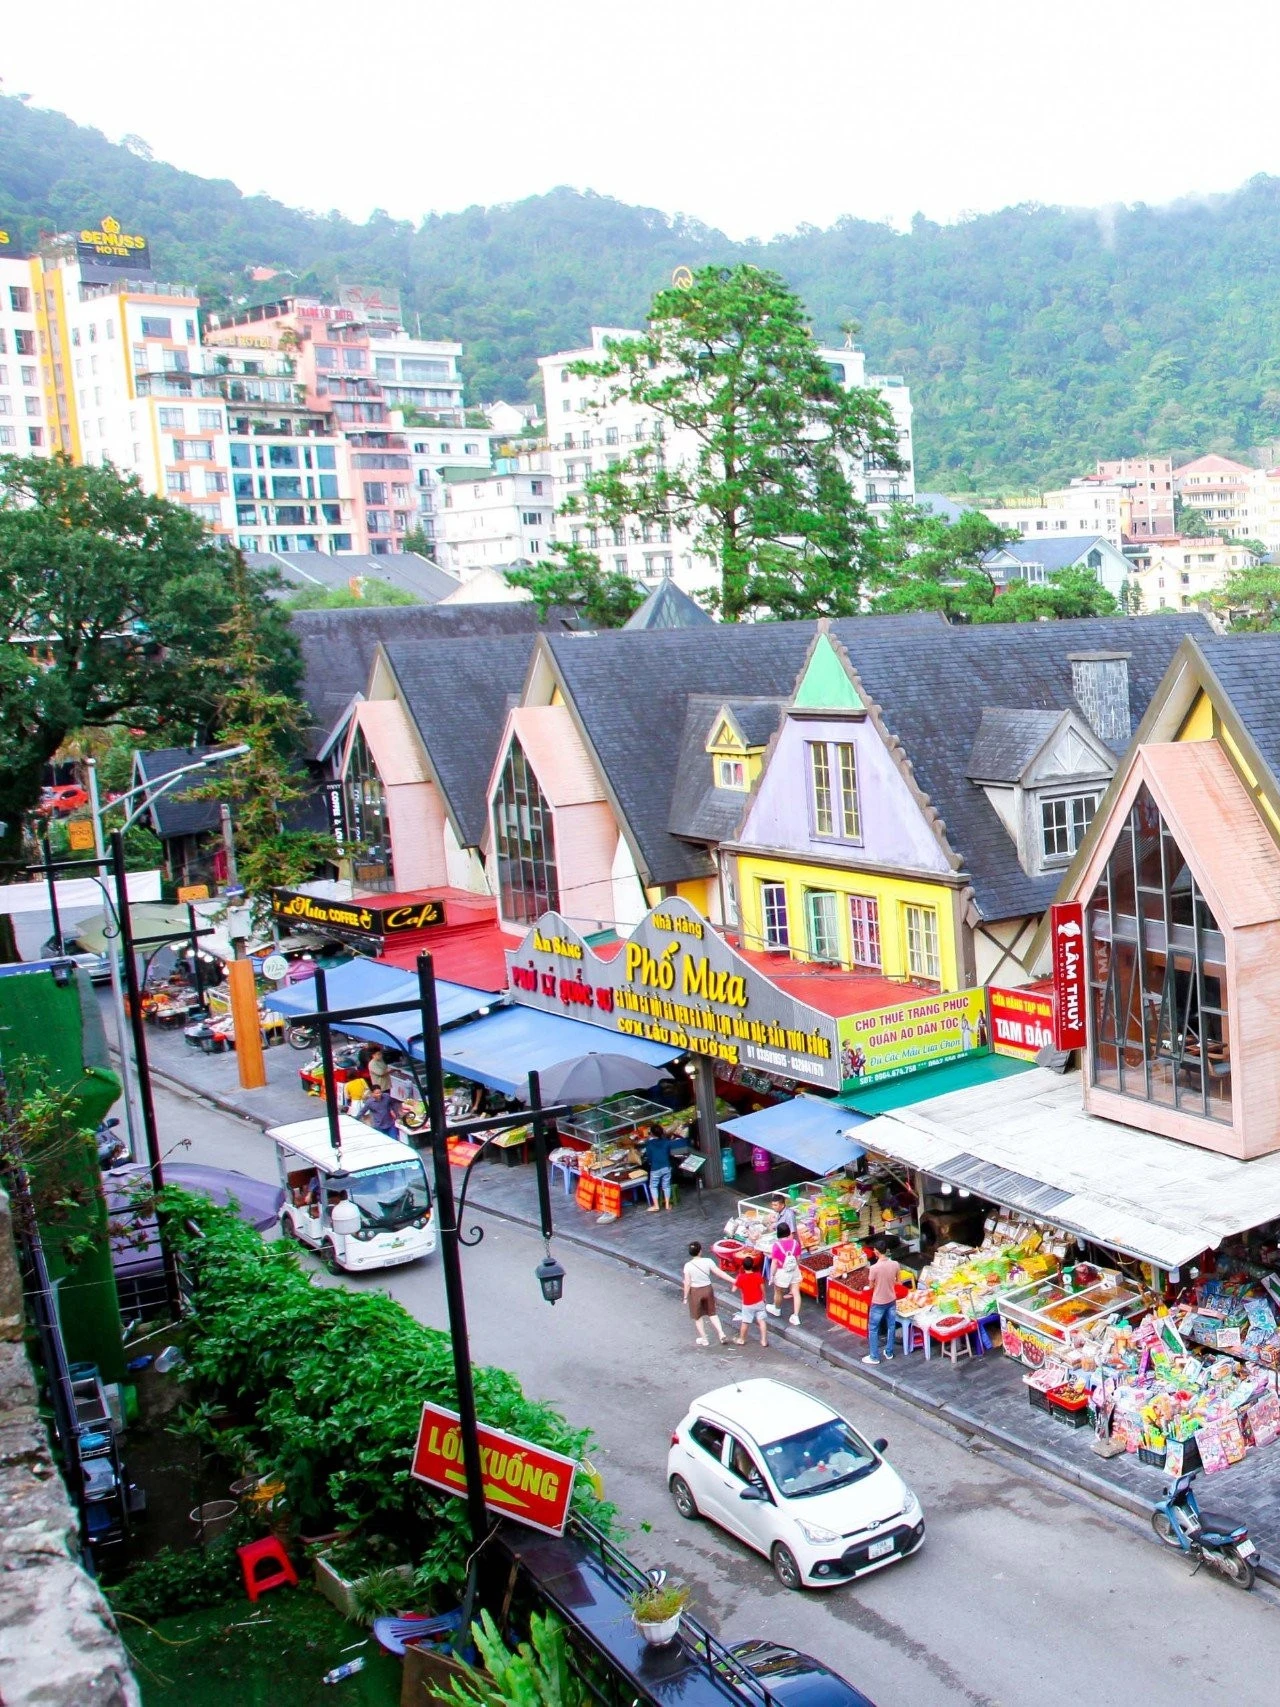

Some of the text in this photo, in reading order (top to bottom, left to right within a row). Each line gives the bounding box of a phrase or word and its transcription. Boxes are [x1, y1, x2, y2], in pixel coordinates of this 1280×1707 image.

[80, 230, 146, 249] GENUSS
[95, 246, 131, 256] HOTEL
[331, 791, 341, 816] COFFEE
[328, 909, 360, 927] COFFEE
[387, 904, 438, 928] Café
[652, 913, 703, 940] Nhà Hàng
[1064, 941, 1080, 980] LÂM
[625, 941, 749, 1007] Phố Mưa
[617, 1017, 644, 1036] CƠM
[855, 1017, 876, 1031] CHO
[907, 1003, 940, 1020] TRANG
[900, 1026, 913, 1040] ÁO
[995, 1018, 1052, 1048] TAM ĐẢO
